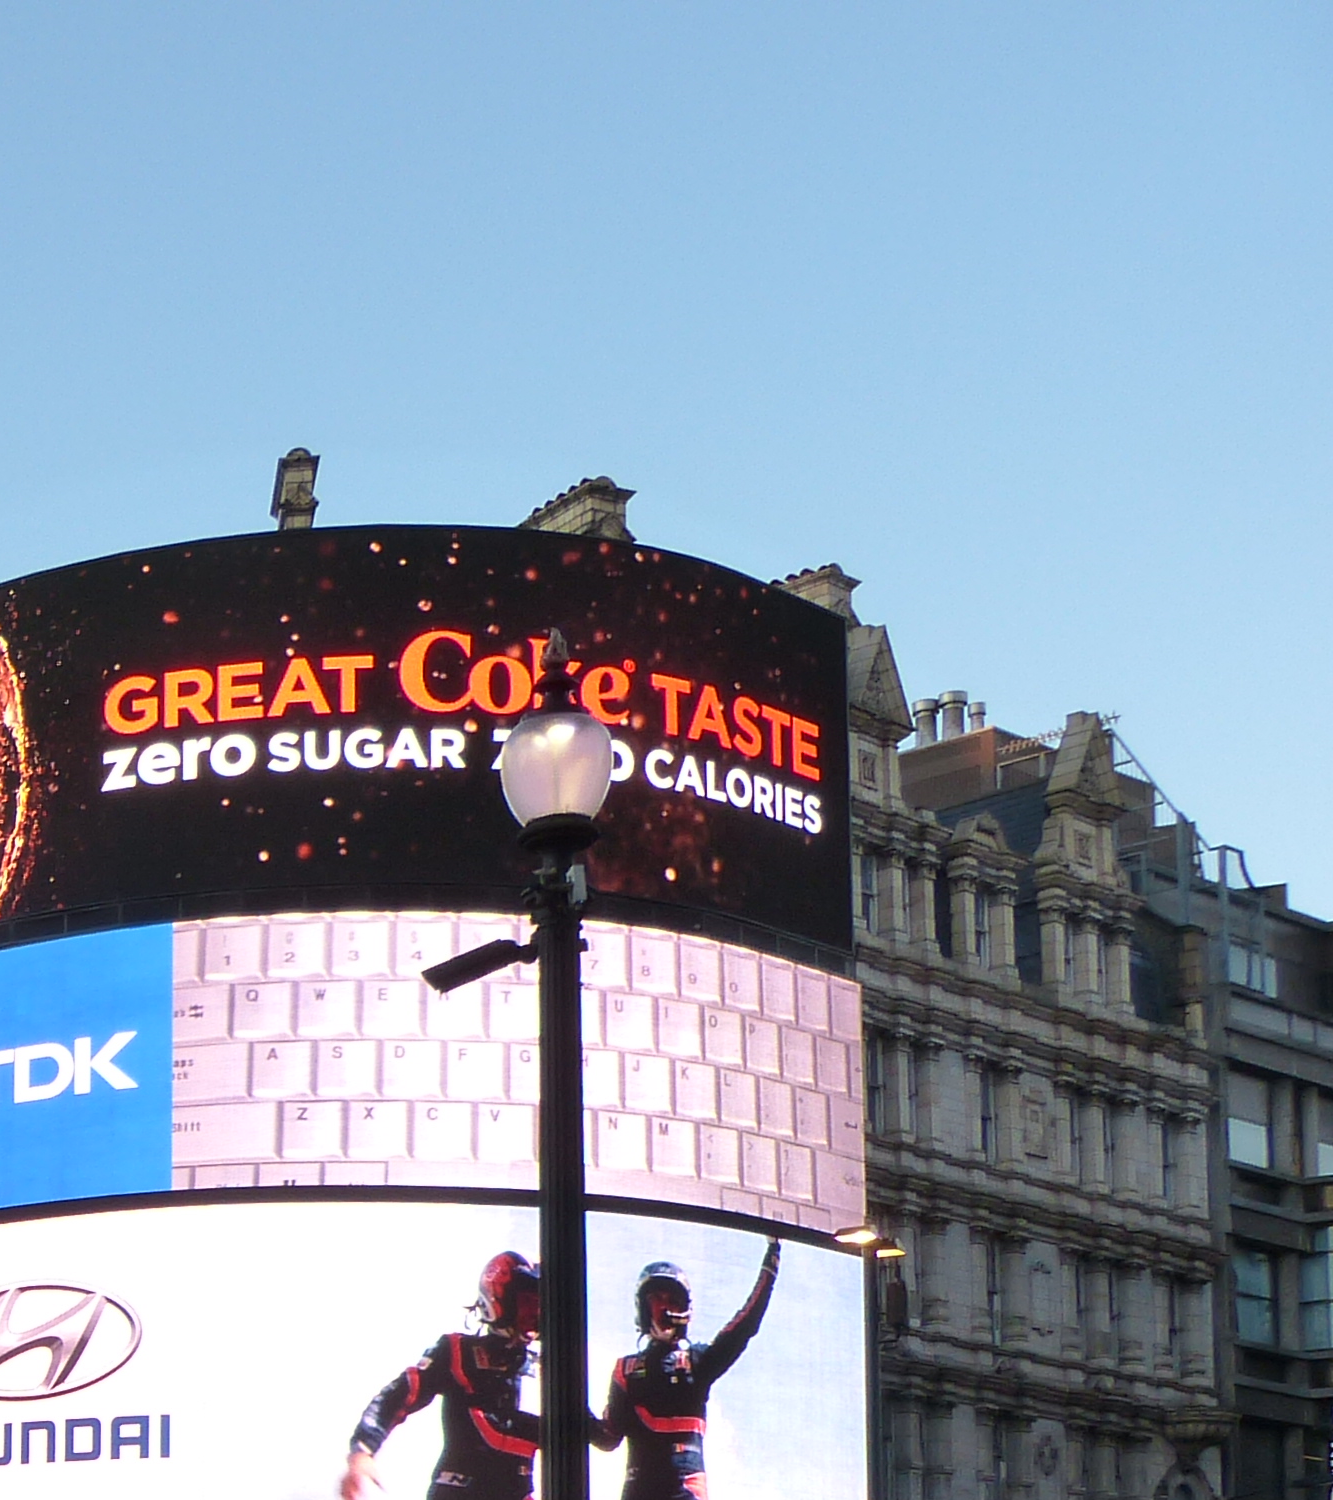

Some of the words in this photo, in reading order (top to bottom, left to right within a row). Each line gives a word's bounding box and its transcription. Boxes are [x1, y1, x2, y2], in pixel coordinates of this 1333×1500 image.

[102, 654, 374, 734] GREAT
[650, 673, 822, 782] TASTE
[101, 734, 257, 794] zero
[268, 727, 466, 773] SUGAR
[645, 747, 823, 835] CALORIES
